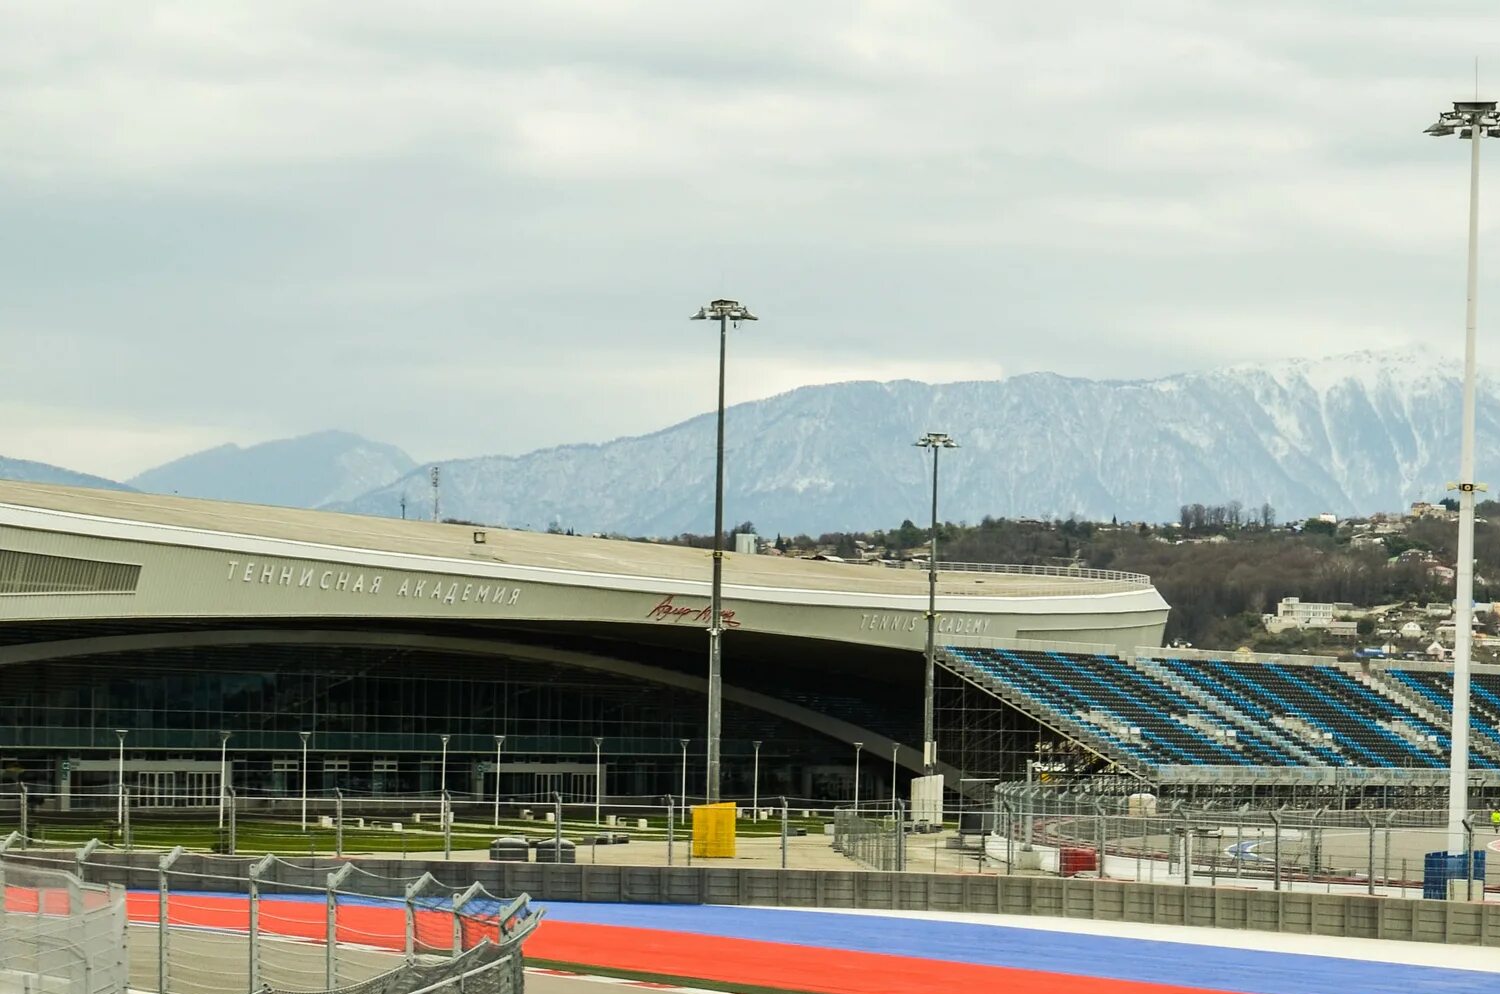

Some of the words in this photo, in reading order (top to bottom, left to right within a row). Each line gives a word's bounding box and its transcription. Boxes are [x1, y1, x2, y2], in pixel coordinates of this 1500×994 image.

[227, 560, 382, 595] ТЕННИСНАЯ
[398, 577, 522, 605] АКАДЕМИЯ
[860, 614, 918, 632] TENNIS
[935, 617, 991, 633] CADEMY
